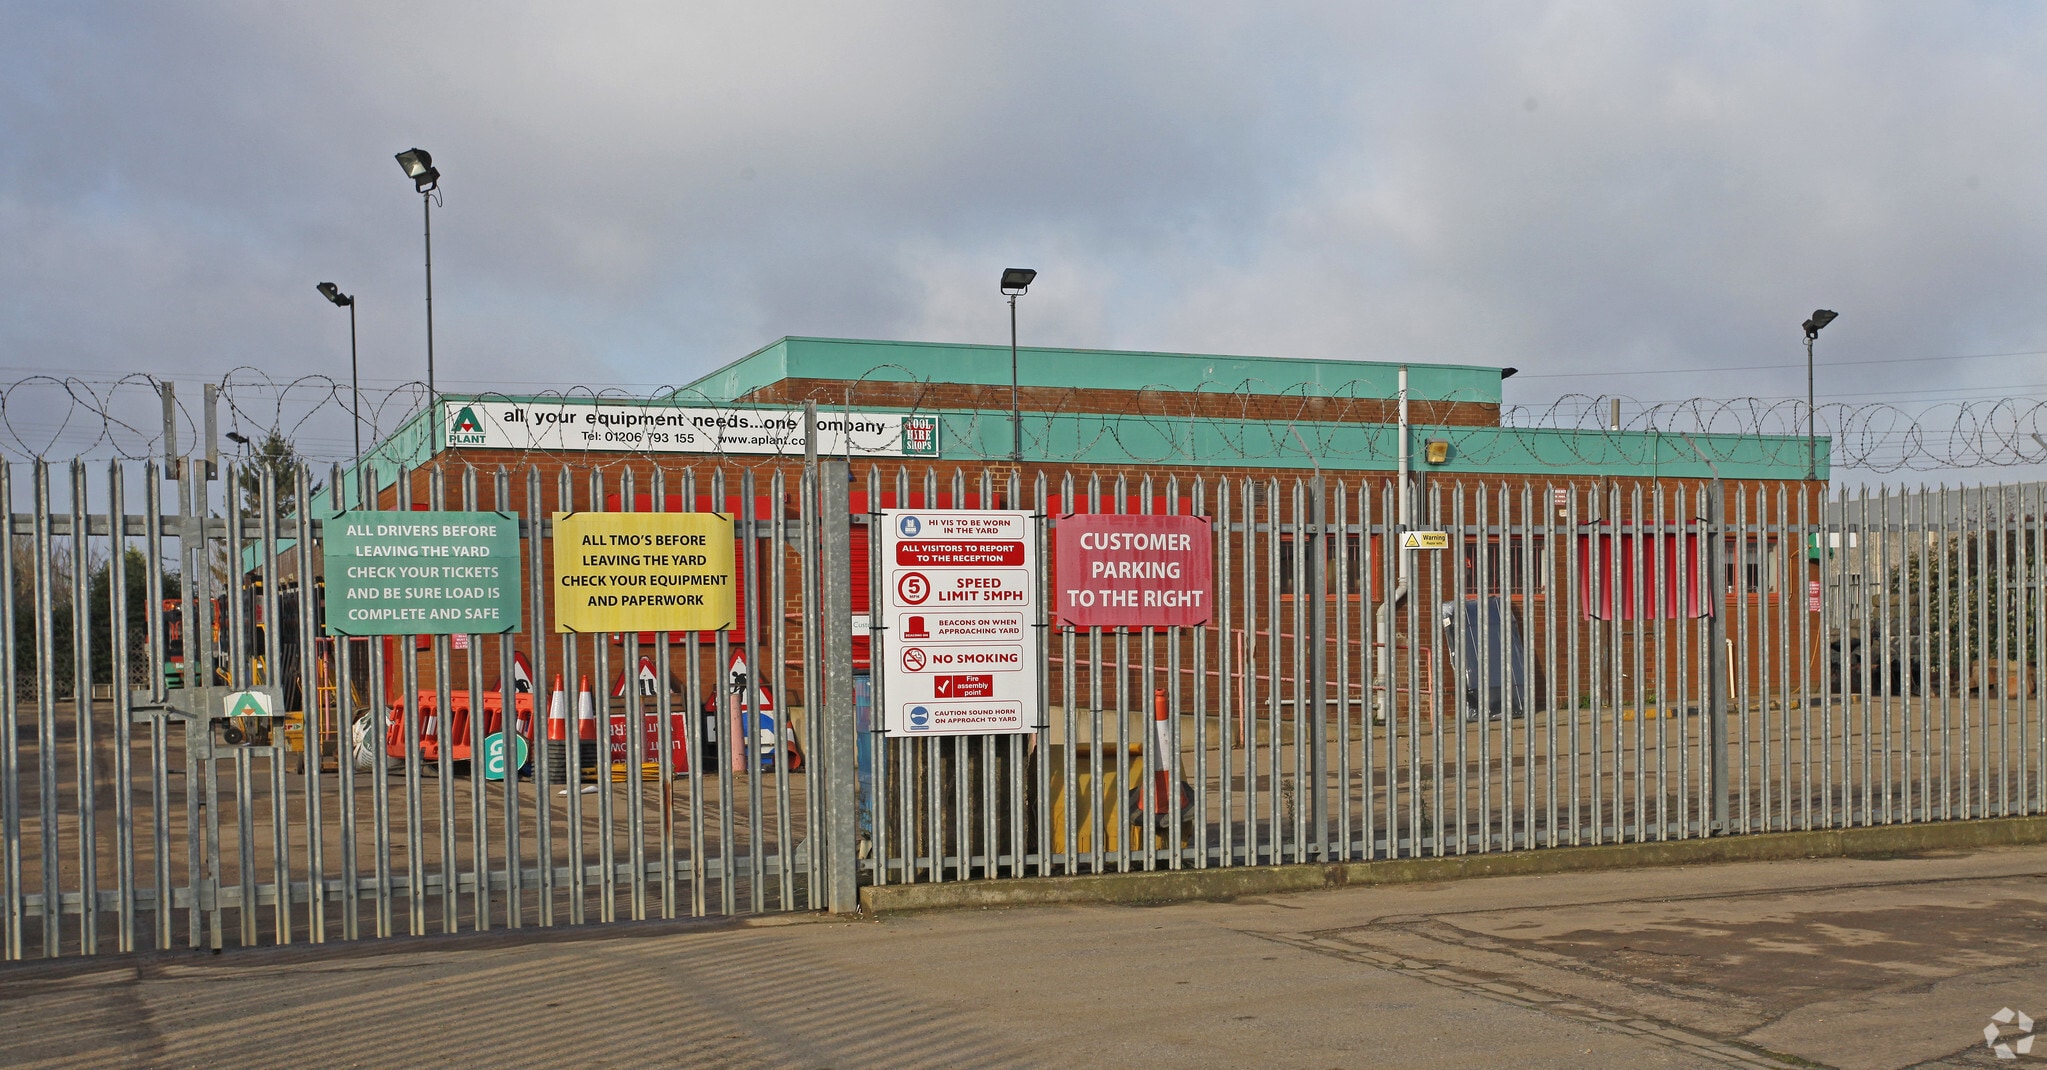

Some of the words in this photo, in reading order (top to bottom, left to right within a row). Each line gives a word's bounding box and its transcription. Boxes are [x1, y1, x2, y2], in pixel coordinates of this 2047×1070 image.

[451, 407, 484, 432] A
[504, 409, 524, 422] all
[535, 412, 576, 426] your
[585, 411, 684, 428] equipment
[817, 420, 885, 435] ompany
[907, 419, 931, 429] TOOL
[449, 435, 486, 444] PLANT
[582, 431, 601, 441] Tel:
[605, 432, 642, 442] 01206
[648, 433, 669, 443] 793
[674, 433, 695, 443] 155
[719, 434, 806, 446] www.aplant.co
[907, 430, 931, 440] HIRE
[906, 440, 932, 450] SHOPS
[346, 525, 373, 537] ALL
[377, 525, 438, 537] DRIVERS
[442, 525, 497, 537] BEFORE
[582, 535, 606, 546] ALL
[609, 535, 652, 546] TMO'S
[656, 535, 706, 546] BEFORE
[1080, 532, 1191, 551] CUSTOMER
[356, 546, 418, 557] LEAVING
[421, 546, 449, 557] THE
[452, 546, 490, 557] YARD
[583, 555, 640, 566] LEAVING
[643, 555, 668, 566] THE
[672, 555, 706, 566] YARD
[348, 567, 396, 578] CHECK
[399, 567, 439, 578] YOUR
[442, 567, 499, 578] TICKETS
[1092, 562, 1180, 579] PARKING
[562, 575, 607, 587] CHECK
[609, 575, 646, 587] YOUR
[650, 575, 728, 587] EQUIPMENT
[908, 579, 920, 594] 5
[957, 578, 1001, 588] SPEED
[346, 587, 380, 599] AND
[384, 587, 401, 599] BE
[405, 587, 442, 599] SURE
[445, 587, 484, 599] LOAD
[488, 587, 500, 599] IS
[939, 591, 978, 601] LIMIT
[984, 591, 1023, 601] 5MPH
[1066, 590, 1094, 607] TO
[1098, 590, 1139, 607] THE
[1144, 590, 1203, 607] RIGHT
[588, 595, 618, 606] AND
[621, 595, 704, 606] PAPERWORK
[348, 608, 426, 620] COMPLETE
[429, 608, 461, 620] AND
[465, 608, 499, 620] SAFE
[933, 654, 953, 664] NO
[957, 653, 1018, 663] SMOKING
